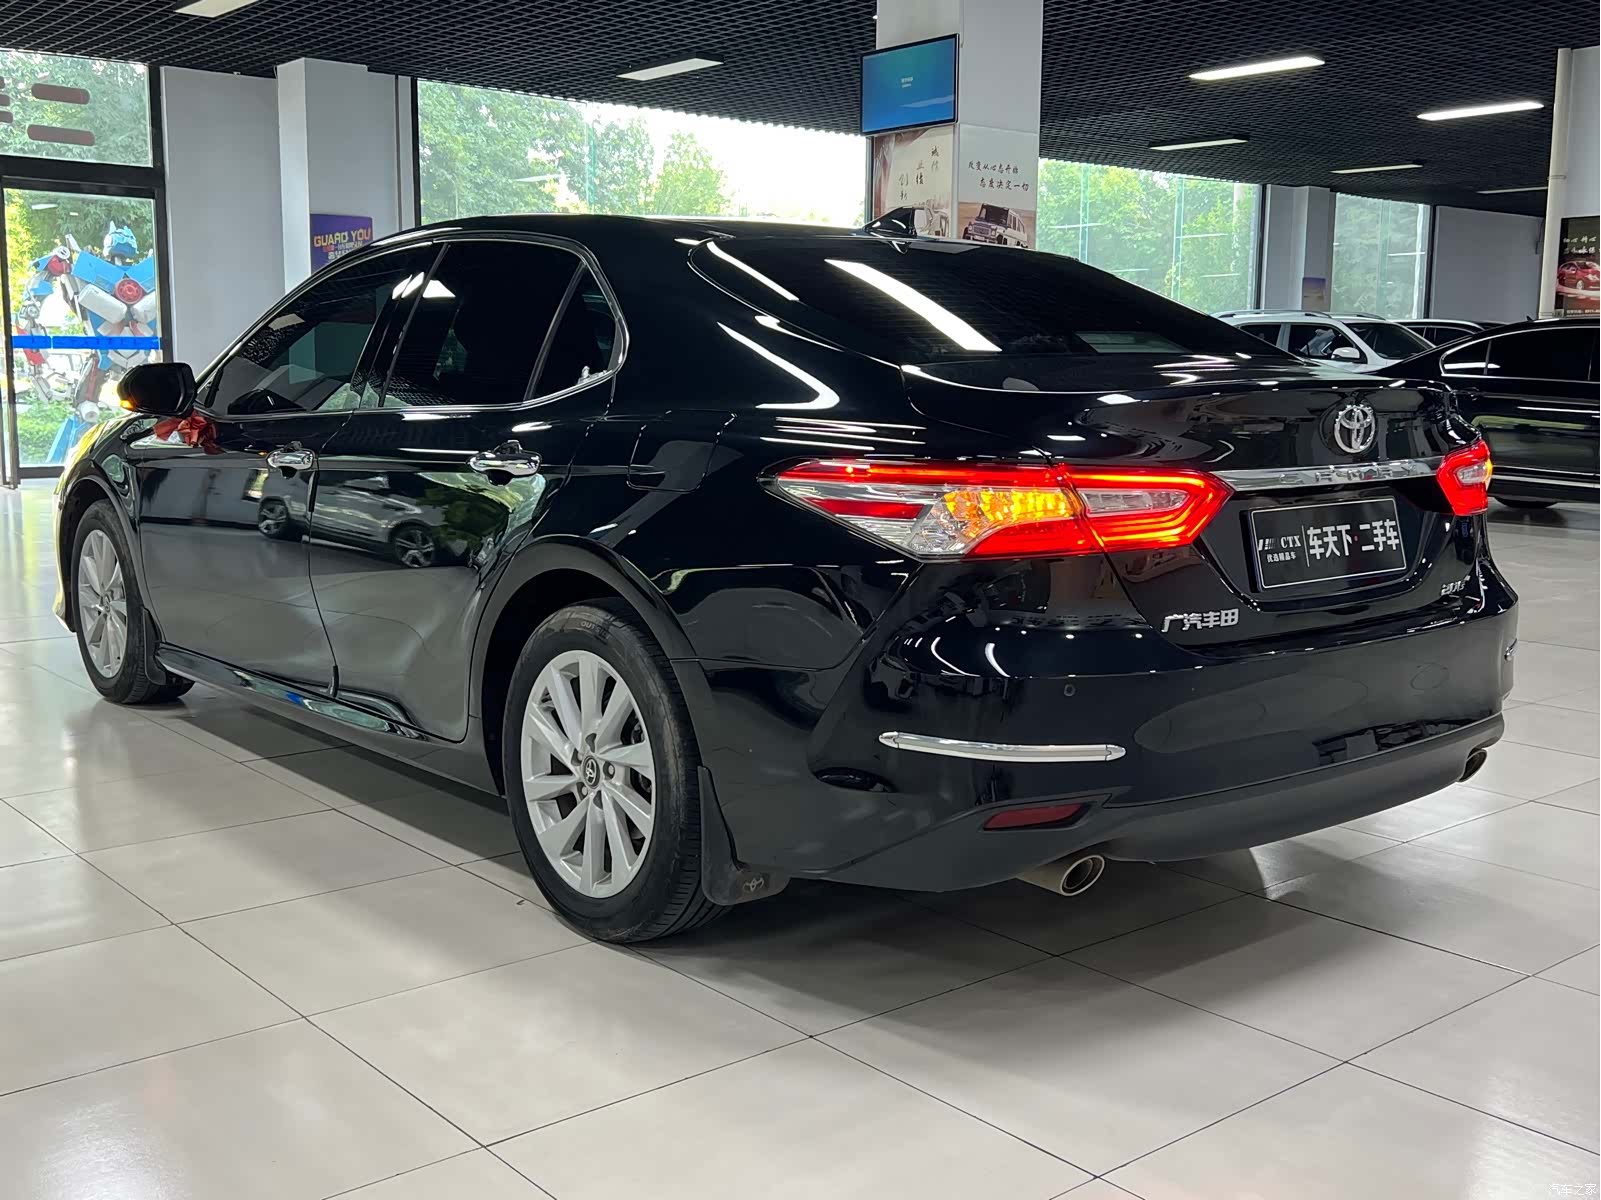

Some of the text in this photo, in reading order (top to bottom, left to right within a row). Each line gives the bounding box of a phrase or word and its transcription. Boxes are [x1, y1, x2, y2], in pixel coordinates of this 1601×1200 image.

[979, 177, 1030, 192] 态度决定一切
[313, 231, 349, 247] GUARD
[351, 228, 371, 242] YOU
[1280, 534, 1302, 549] CTX
[1266, 551, 1297, 563] 优选精品车
[1161, 608, 1239, 633] 广汽丰田
